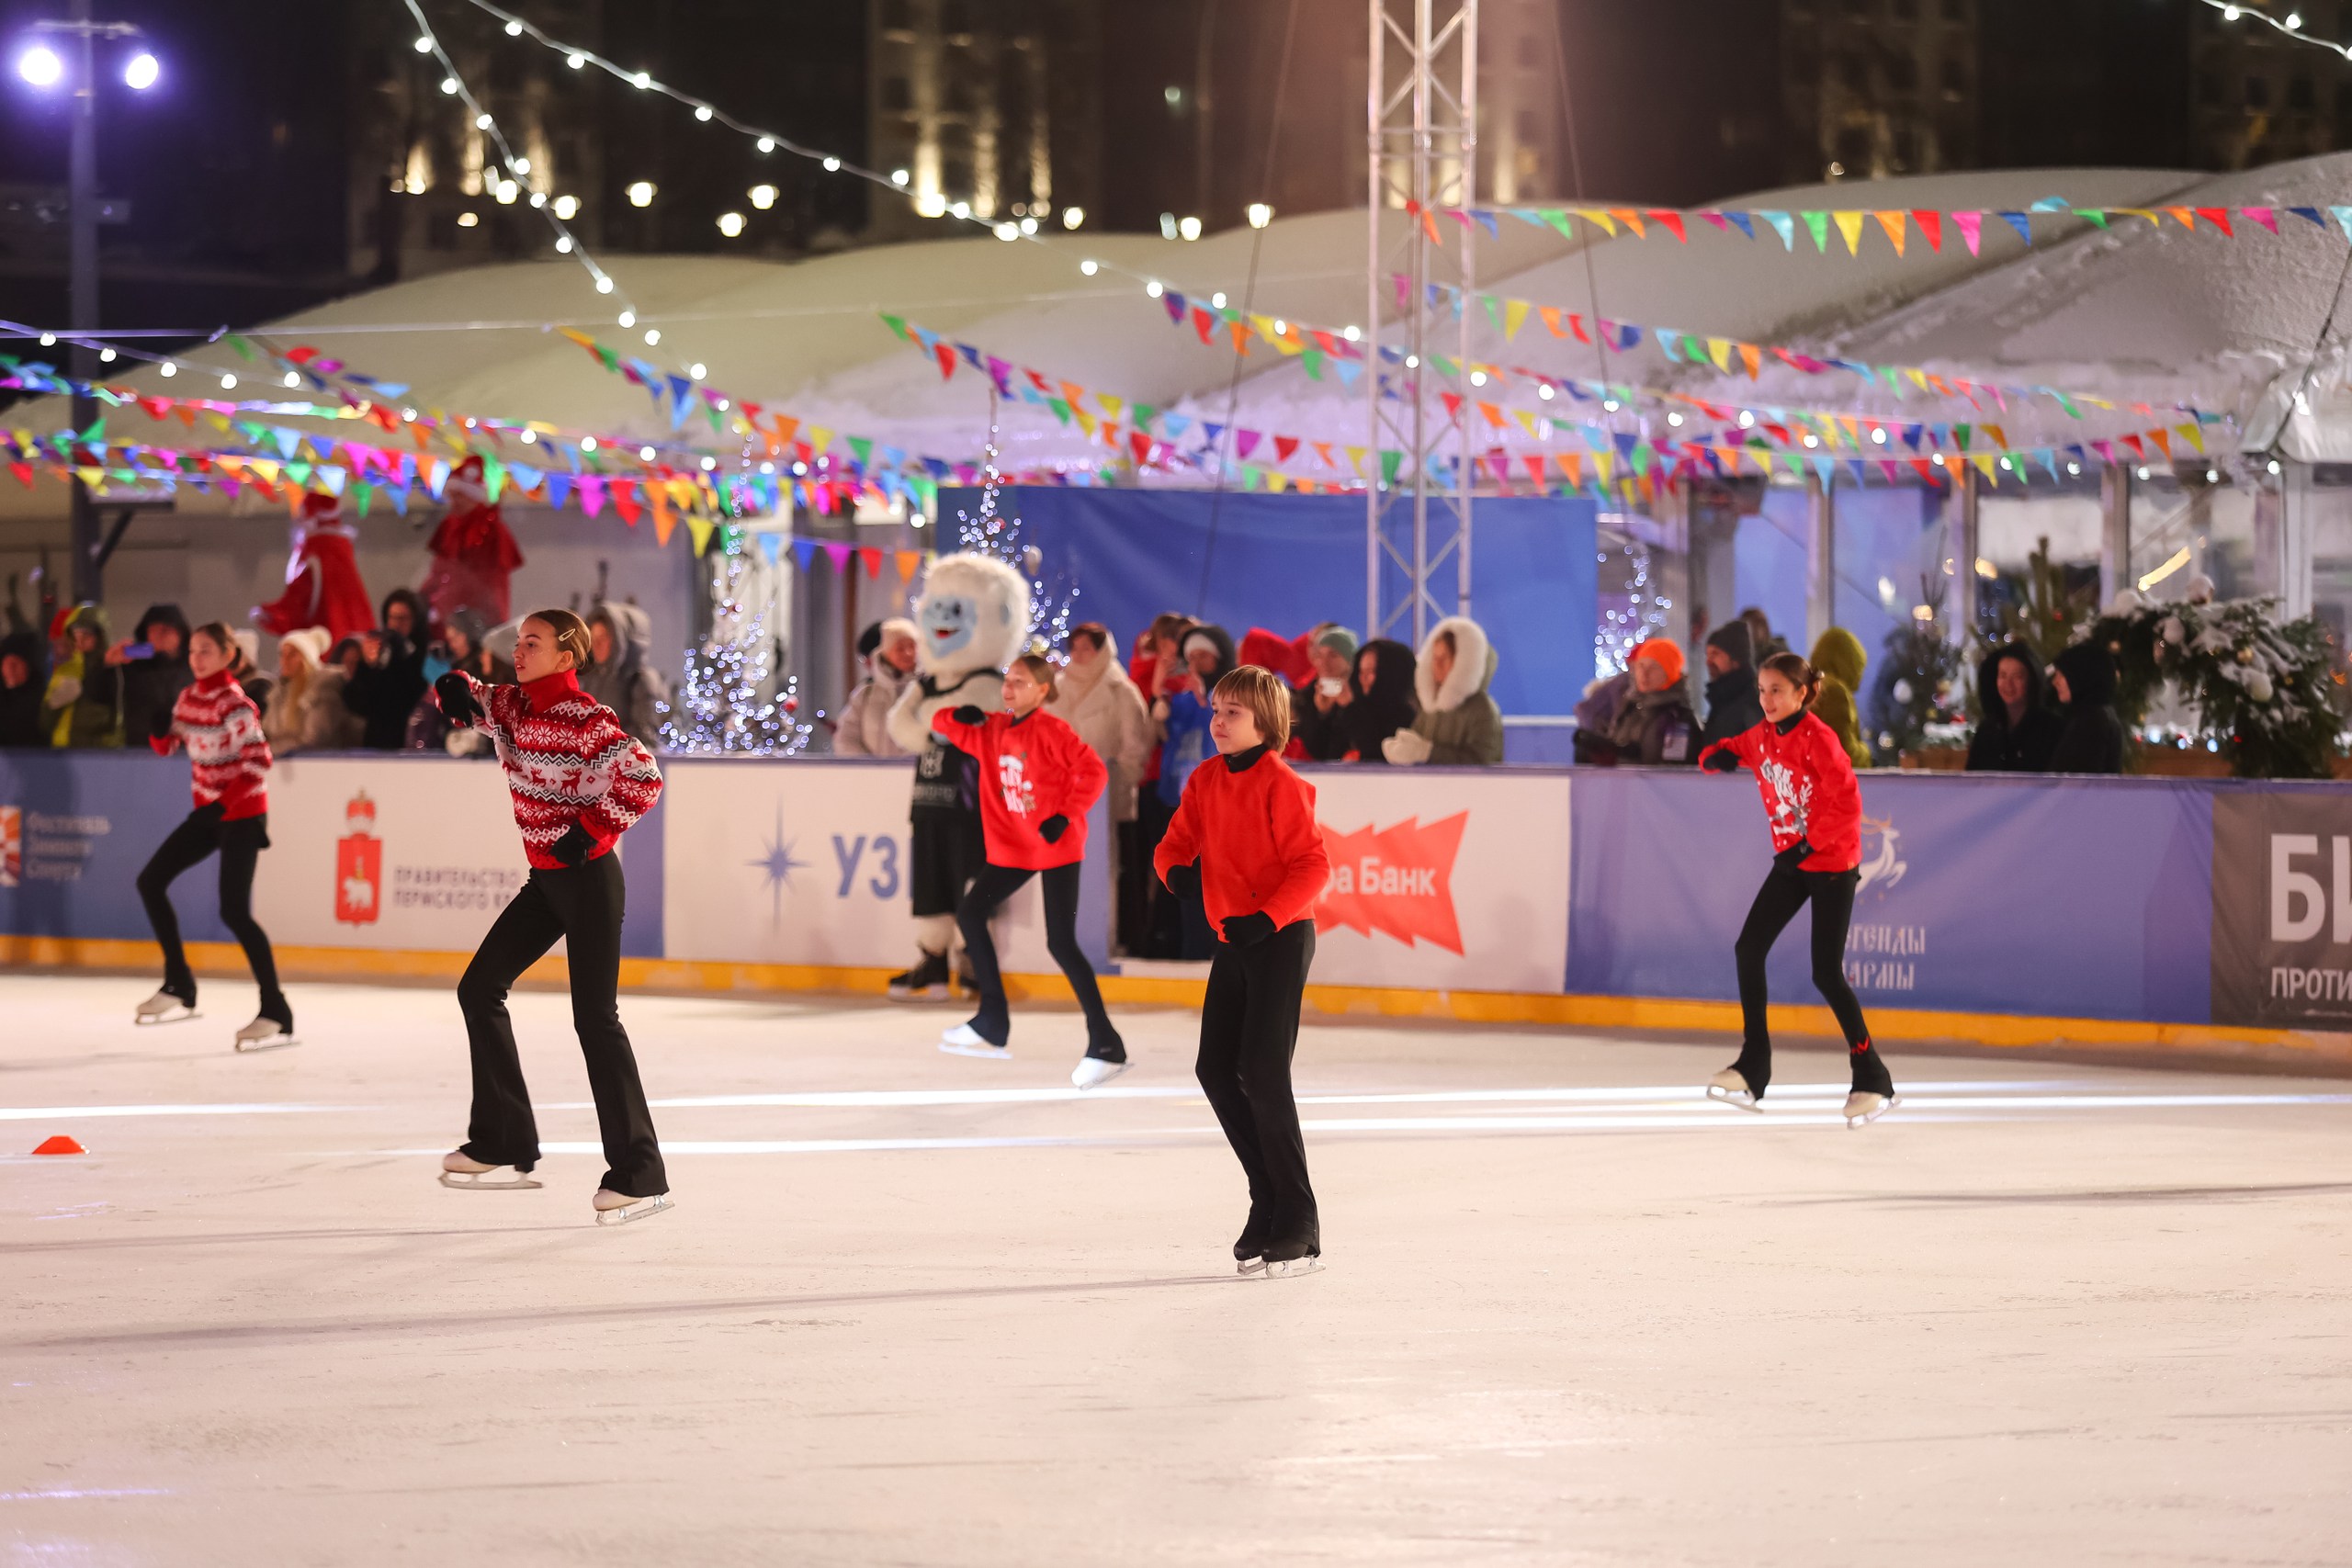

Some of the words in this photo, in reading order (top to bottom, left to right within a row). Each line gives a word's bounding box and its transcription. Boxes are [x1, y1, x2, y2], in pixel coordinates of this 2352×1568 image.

[395, 866, 521, 888] ПРАВИТЕЛЬСТВО
[831, 834, 913, 898] УЗ
[1360, 856, 1436, 897] Банк
